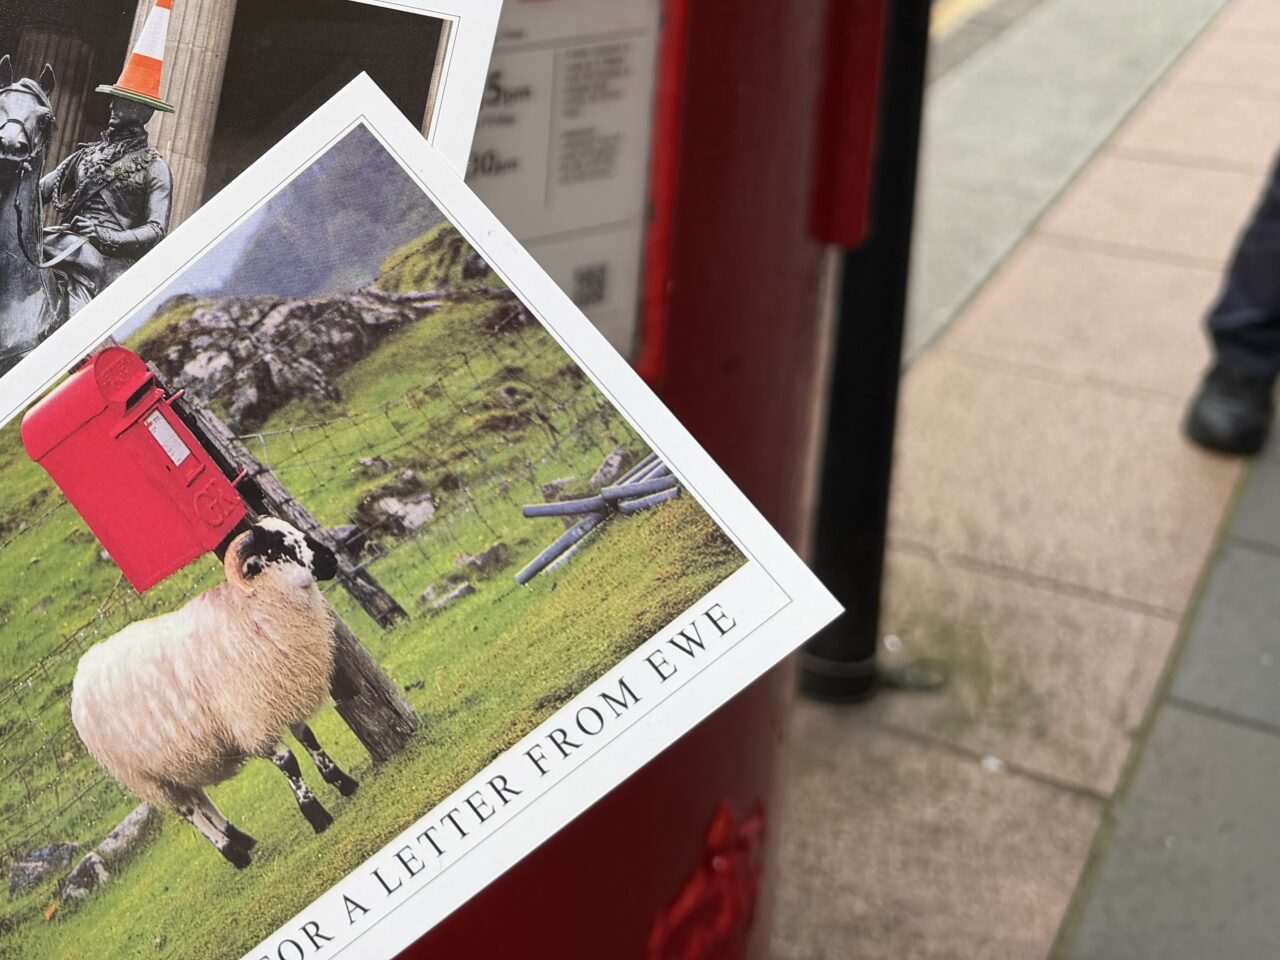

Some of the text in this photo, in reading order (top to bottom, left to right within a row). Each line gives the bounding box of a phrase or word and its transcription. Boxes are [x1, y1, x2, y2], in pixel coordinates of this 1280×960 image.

[258, 602, 737, 960] OR A LETTER FROM EWE
